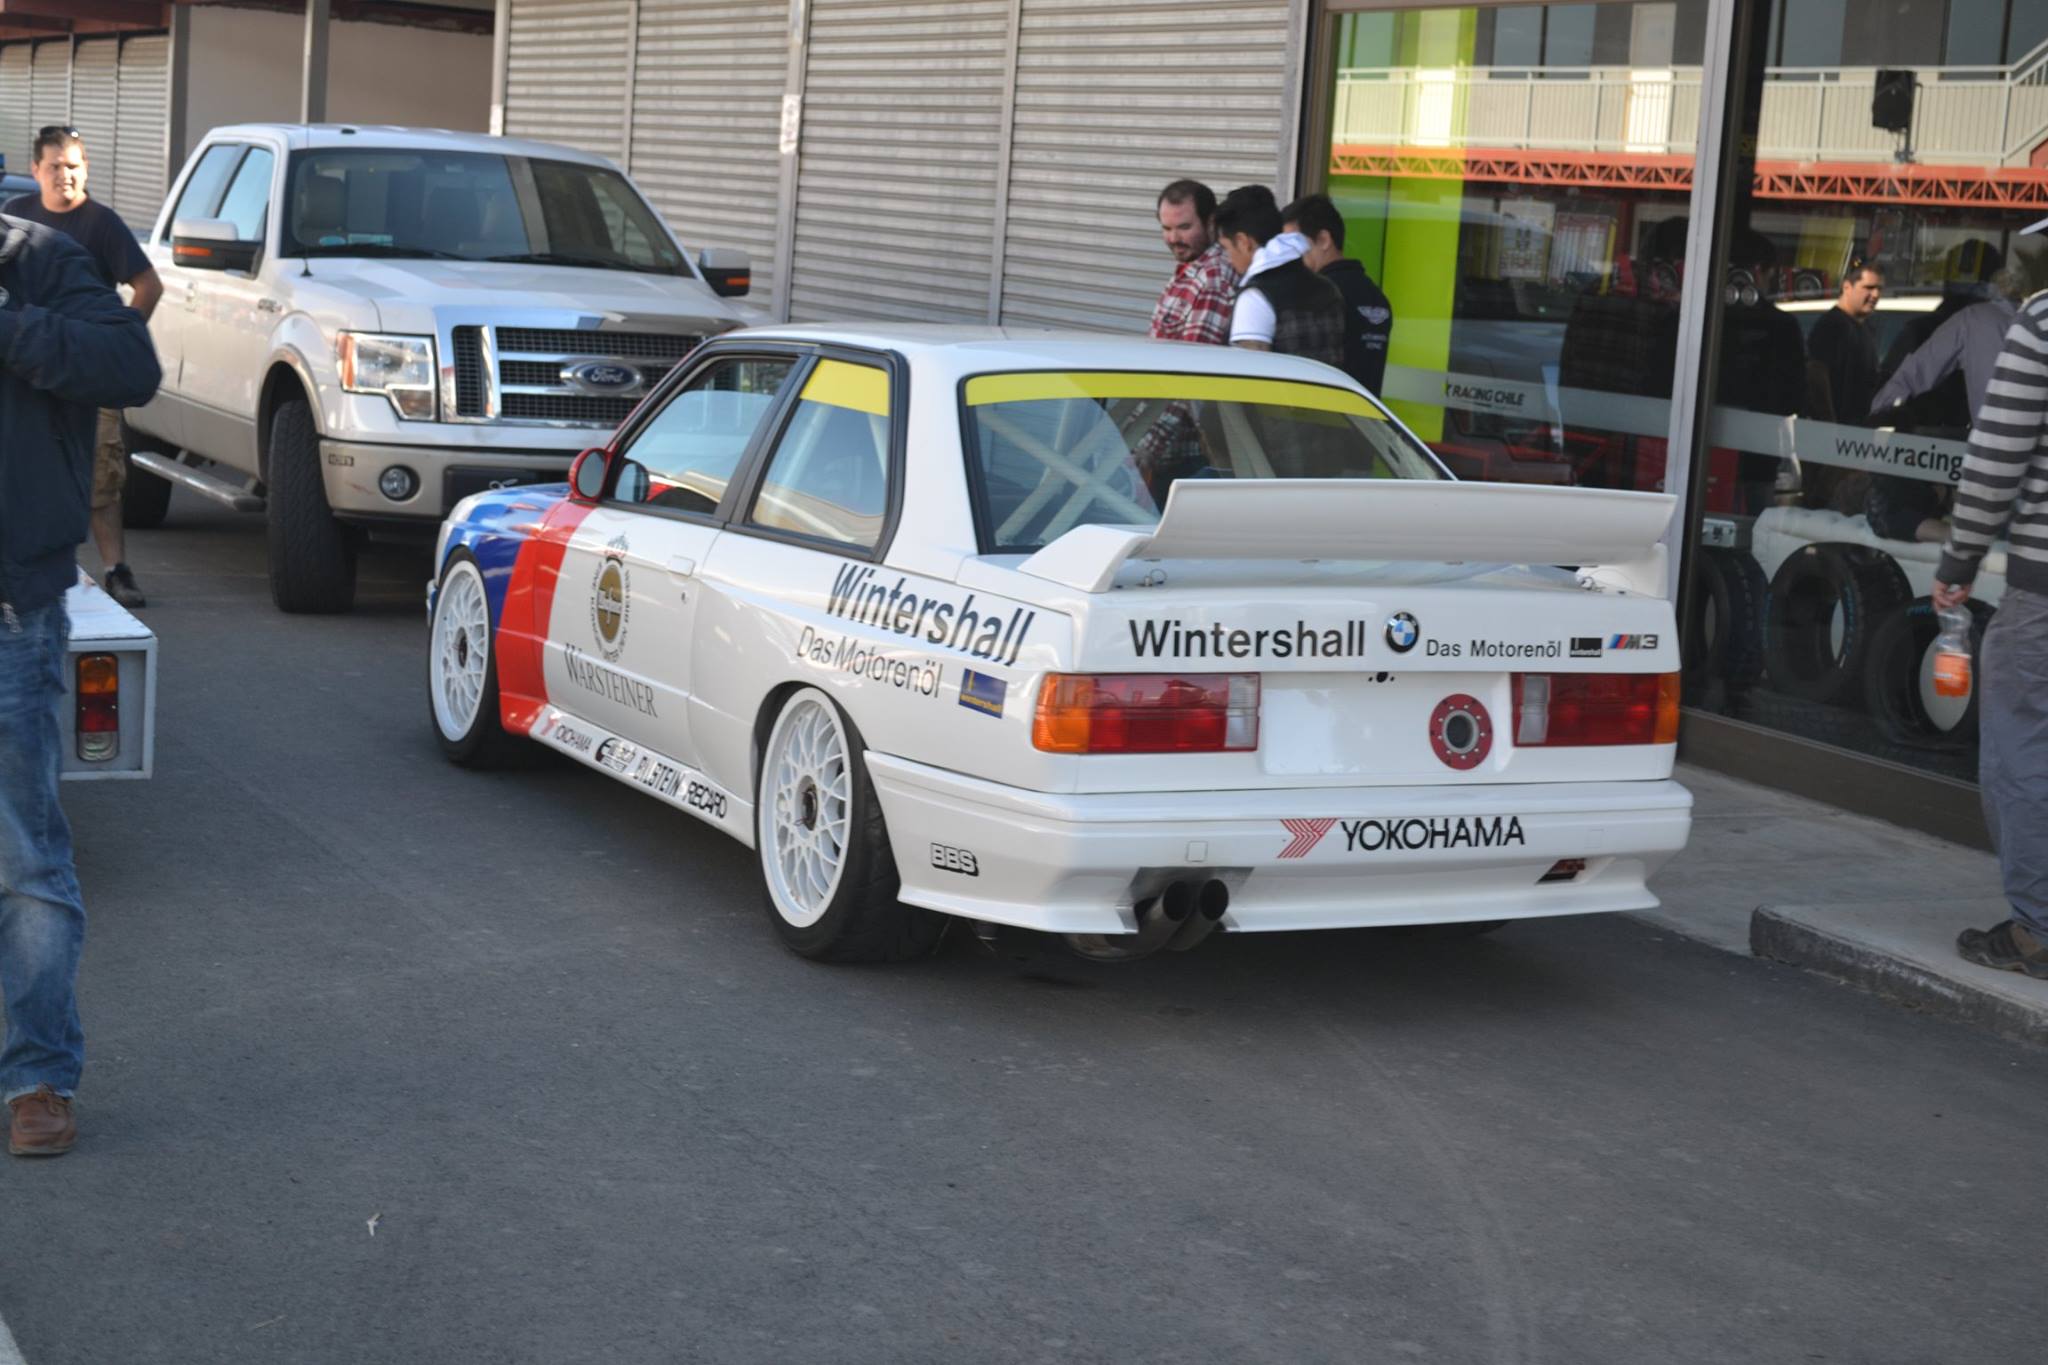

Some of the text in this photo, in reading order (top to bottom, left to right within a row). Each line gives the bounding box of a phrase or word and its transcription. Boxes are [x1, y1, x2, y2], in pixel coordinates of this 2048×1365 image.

[591, 367, 624, 383] Ford
[1452, 384, 1493, 402] RACING
[1835, 438, 1963, 481] www.racing
[826, 562, 1036, 667] Wintershall
[1128, 619, 1365, 658] Wintershall
[1425, 639, 1562, 658] Das Motorenöl
[1621, 634, 1659, 649] M3
[797, 625, 944, 698] Das Motorenöl
[564, 643, 658, 718] WARSTEINER
[682, 780, 728, 819] RECARO
[1340, 815, 1526, 851] YOKOHAMA
[930, 842, 980, 877] BBS
